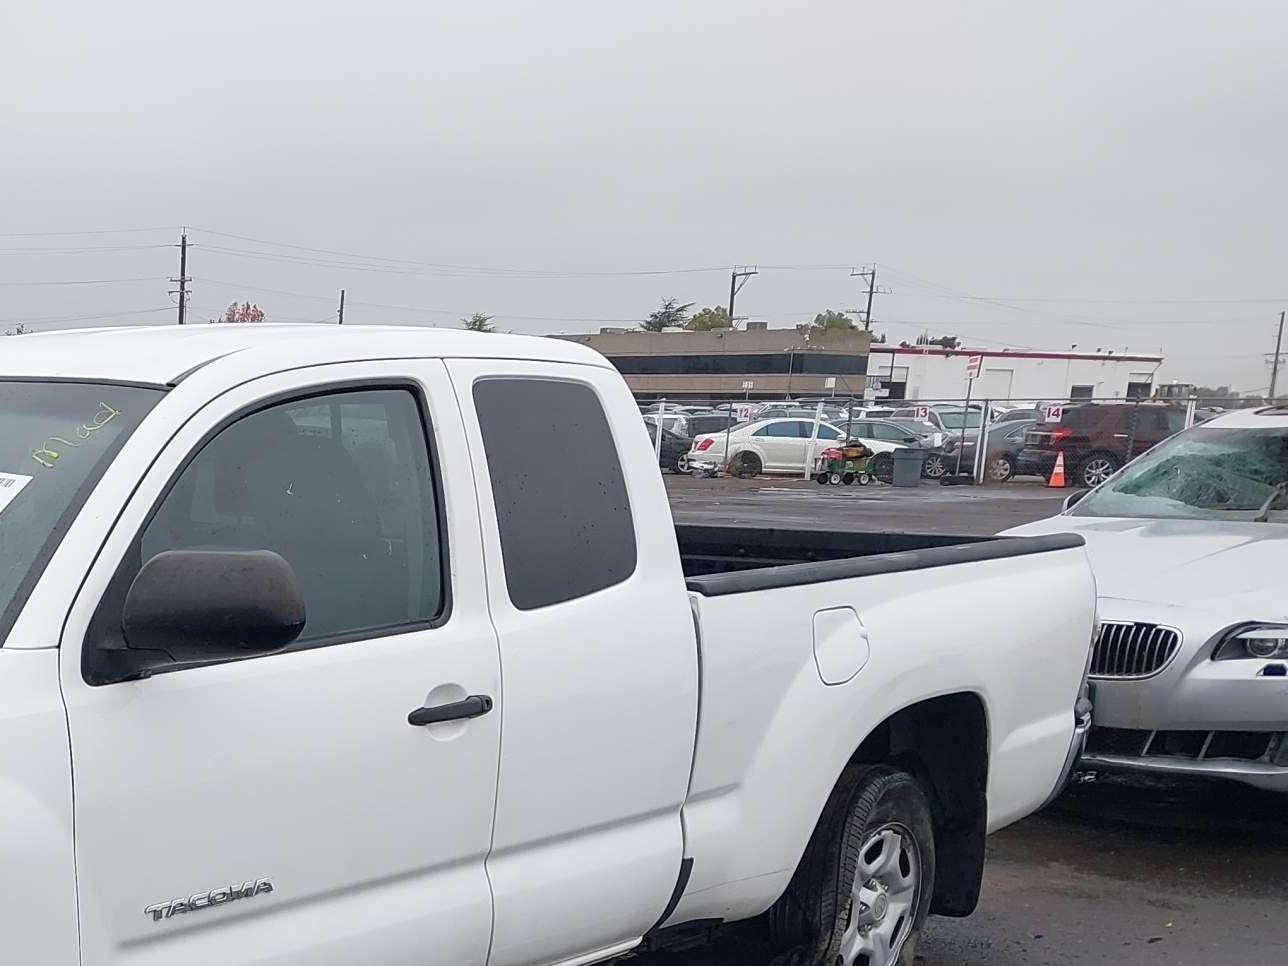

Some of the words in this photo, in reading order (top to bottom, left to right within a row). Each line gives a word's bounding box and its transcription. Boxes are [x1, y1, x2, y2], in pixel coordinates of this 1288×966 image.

[916, 408, 927, 417] 13
[1047, 408, 1060, 417] 14
[144, 878, 273, 921] TACOMA
